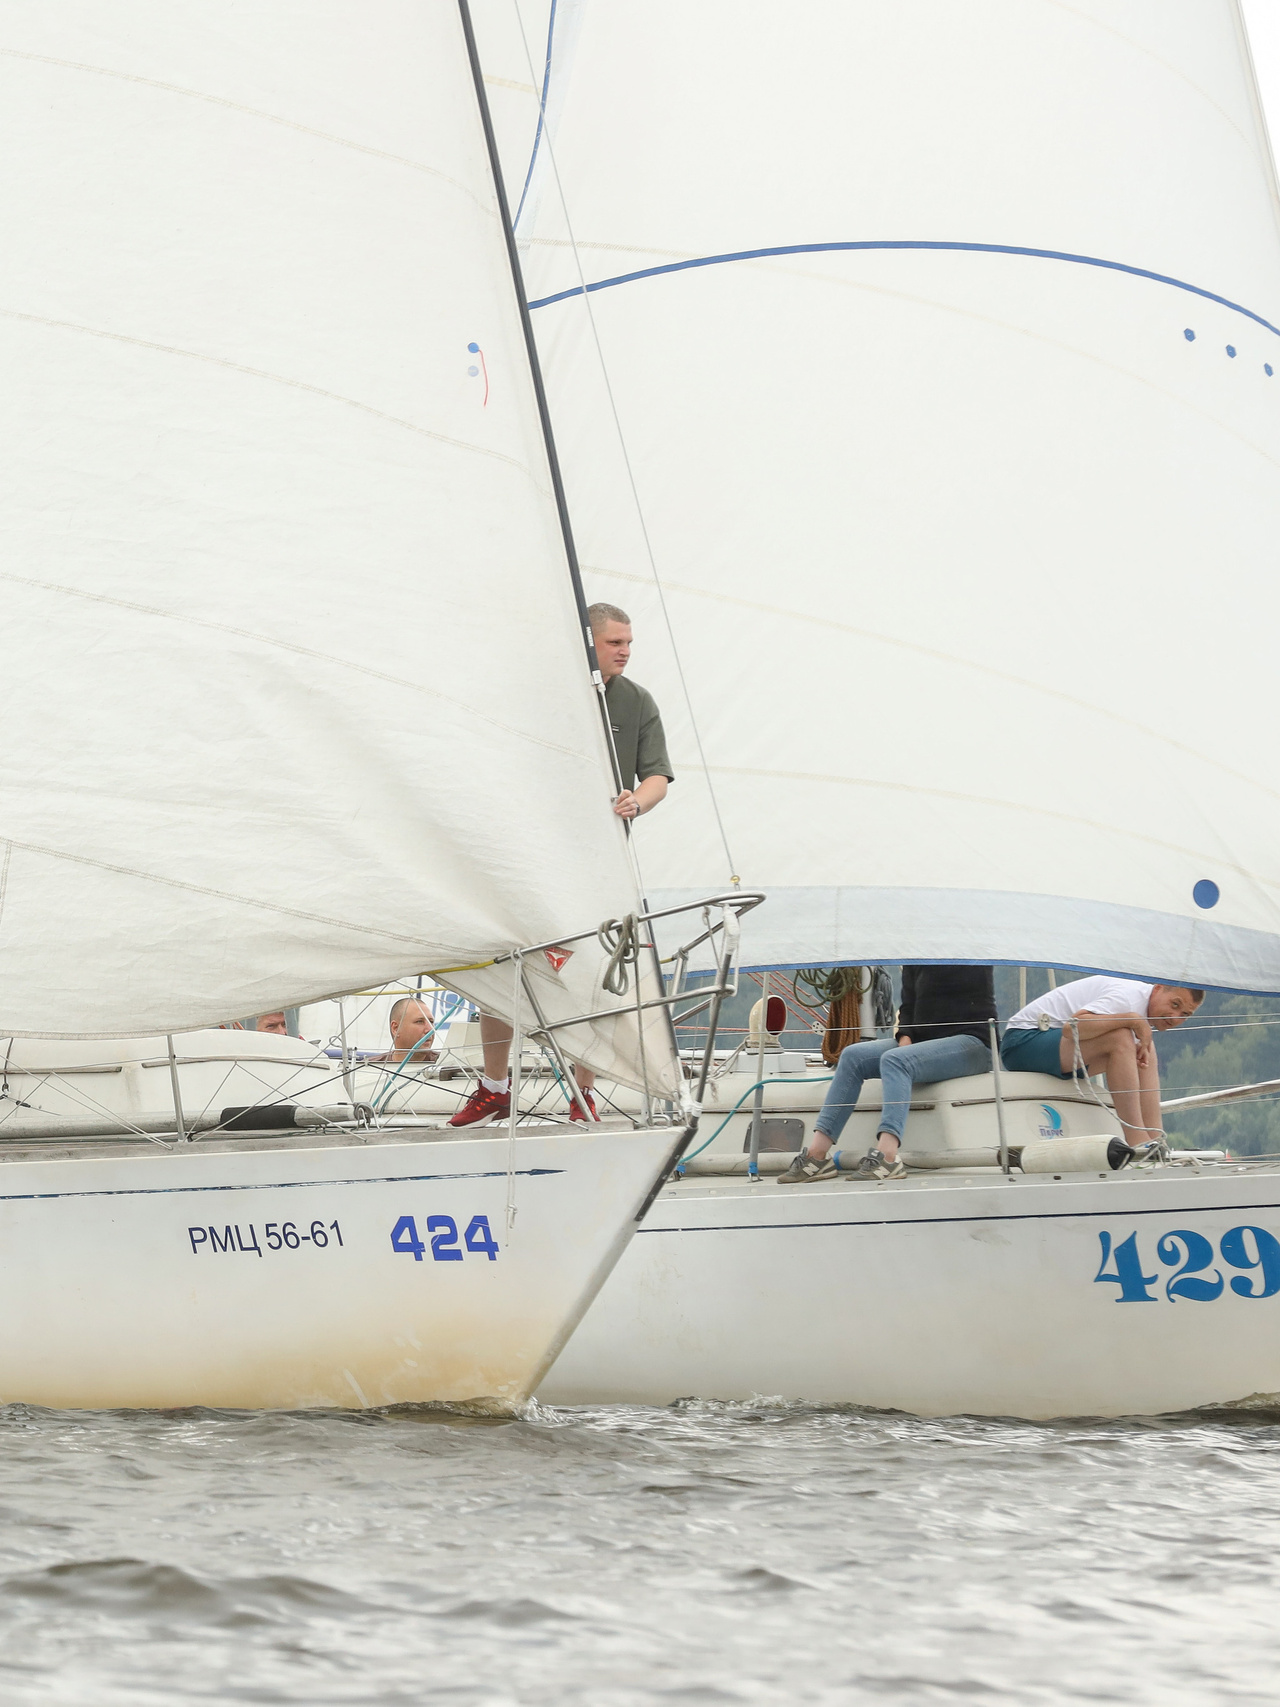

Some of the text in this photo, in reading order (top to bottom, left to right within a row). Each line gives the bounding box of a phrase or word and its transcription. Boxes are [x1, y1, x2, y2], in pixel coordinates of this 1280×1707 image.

[187, 1219, 344, 1258] РМЦ 56-61
[390, 1215, 500, 1261] 424
[1094, 1225, 1280, 1303] 429
